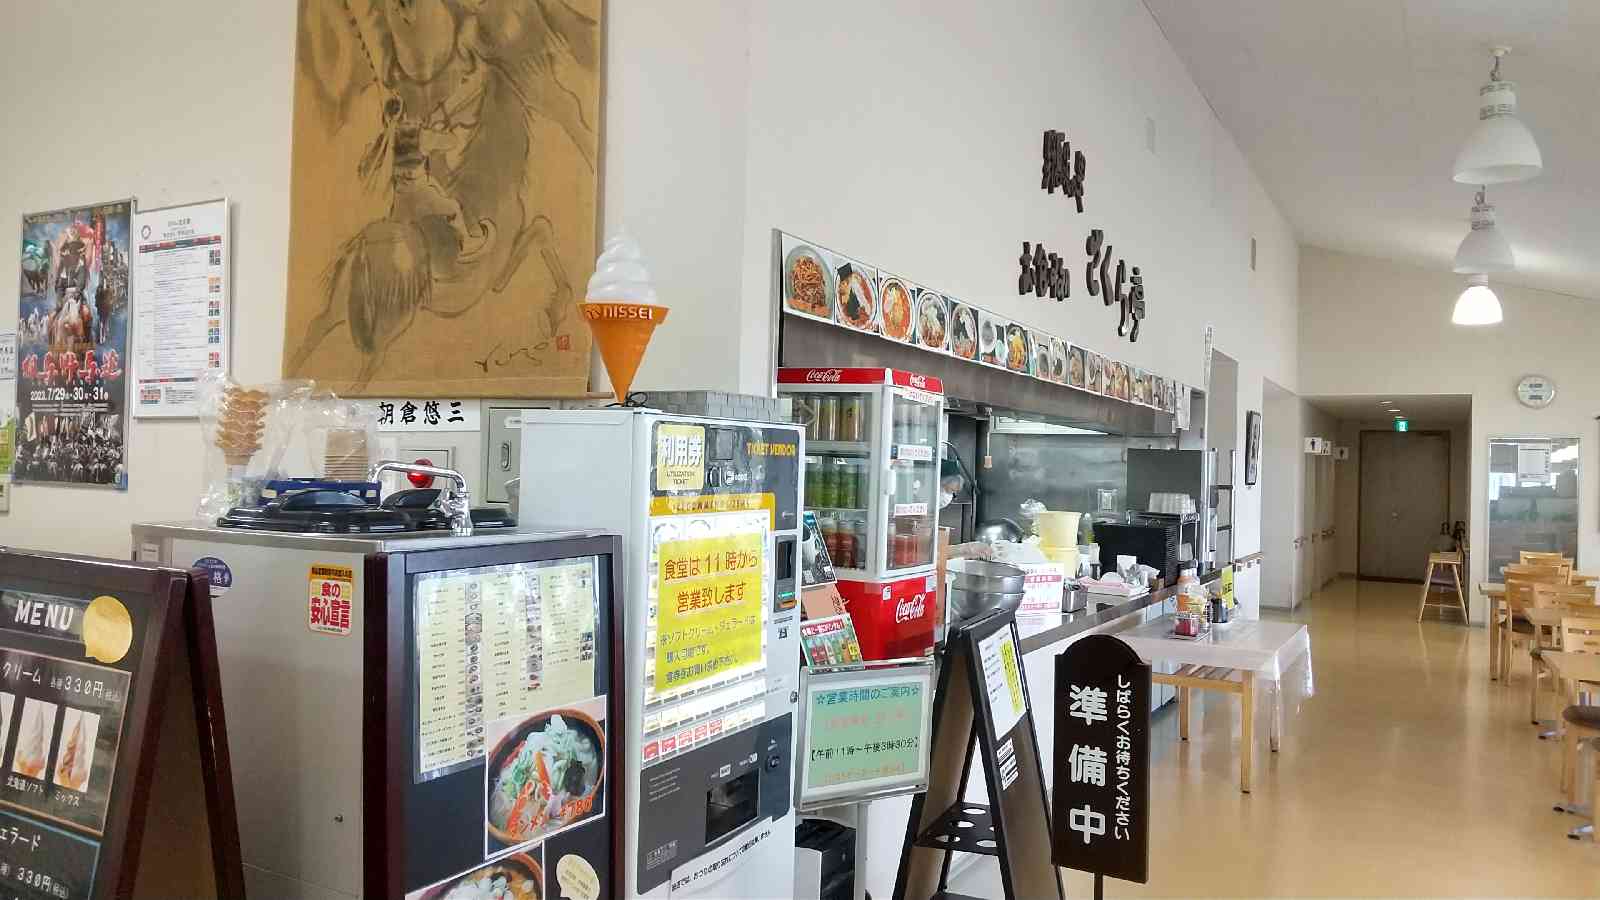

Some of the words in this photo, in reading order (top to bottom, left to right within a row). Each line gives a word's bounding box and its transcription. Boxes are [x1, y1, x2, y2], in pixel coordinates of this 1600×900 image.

[603, 304, 653, 320] NISSEI
[656, 434, 703, 468] 利用券
[321, 582, 341, 598] 食の
[677, 580, 748, 614] 営業致します
[14, 599, 74, 631] MENU
[310, 597, 351, 629] 安心宣言
[1068, 684, 1109, 845] 準備中
[1114, 673, 1132, 841] しばらくお待ちください
